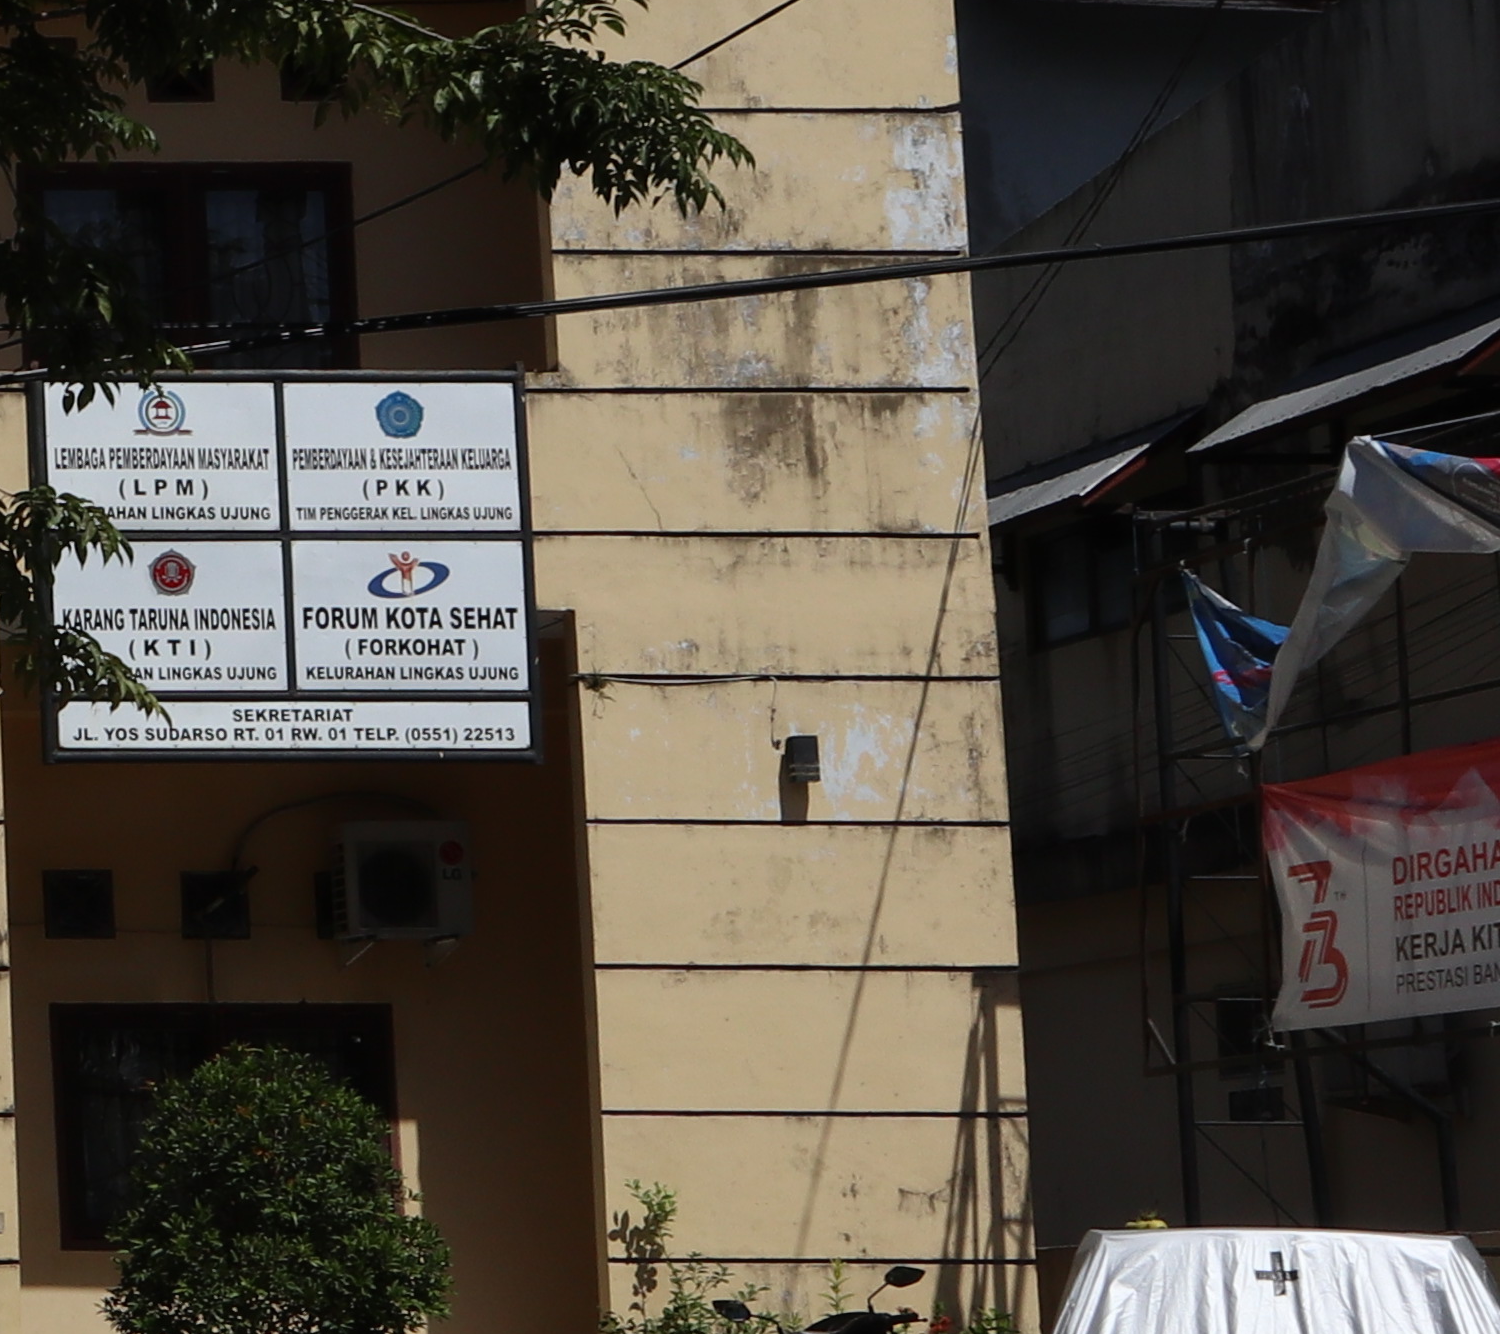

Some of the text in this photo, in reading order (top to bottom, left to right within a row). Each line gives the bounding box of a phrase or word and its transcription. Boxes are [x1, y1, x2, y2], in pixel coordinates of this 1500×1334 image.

[54, 448, 269, 470] LEMBAGA PEMBERDAYAAN MASYARAKAT
[292, 448, 366, 470] PEMBERDAYAAN
[379, 448, 459, 470] KESEJAHTERAAN
[461, 448, 512, 470] KELUARGA
[152, 507, 216, 520] LINGKAS
[221, 507, 271, 520] UJUNG
[296, 507, 513, 520] TIM PENGGERAK KEL. LINGKAS UJUNG
[62, 608, 276, 630] KARANG TARUNA INDONESIA
[303, 607, 518, 629] FORUM KOTA SEHAT
[158, 667, 222, 680] LINGKAS
[227, 667, 277, 680] UJUNG
[306, 667, 519, 680] KELURAHAN LINGKAS UJUNG
[232, 709, 353, 722] SEKRETARIAT
[73, 728, 515, 744] JL. YOS SUDARSO RT. 01 RW. 01 TELP. (0551) 22513
[443, 868, 462, 880] LG
[1393, 884, 1473, 921] REPUBLIK
[1395, 928, 1465, 962] KERJA
[1396, 966, 1469, 995] PRESTASI
